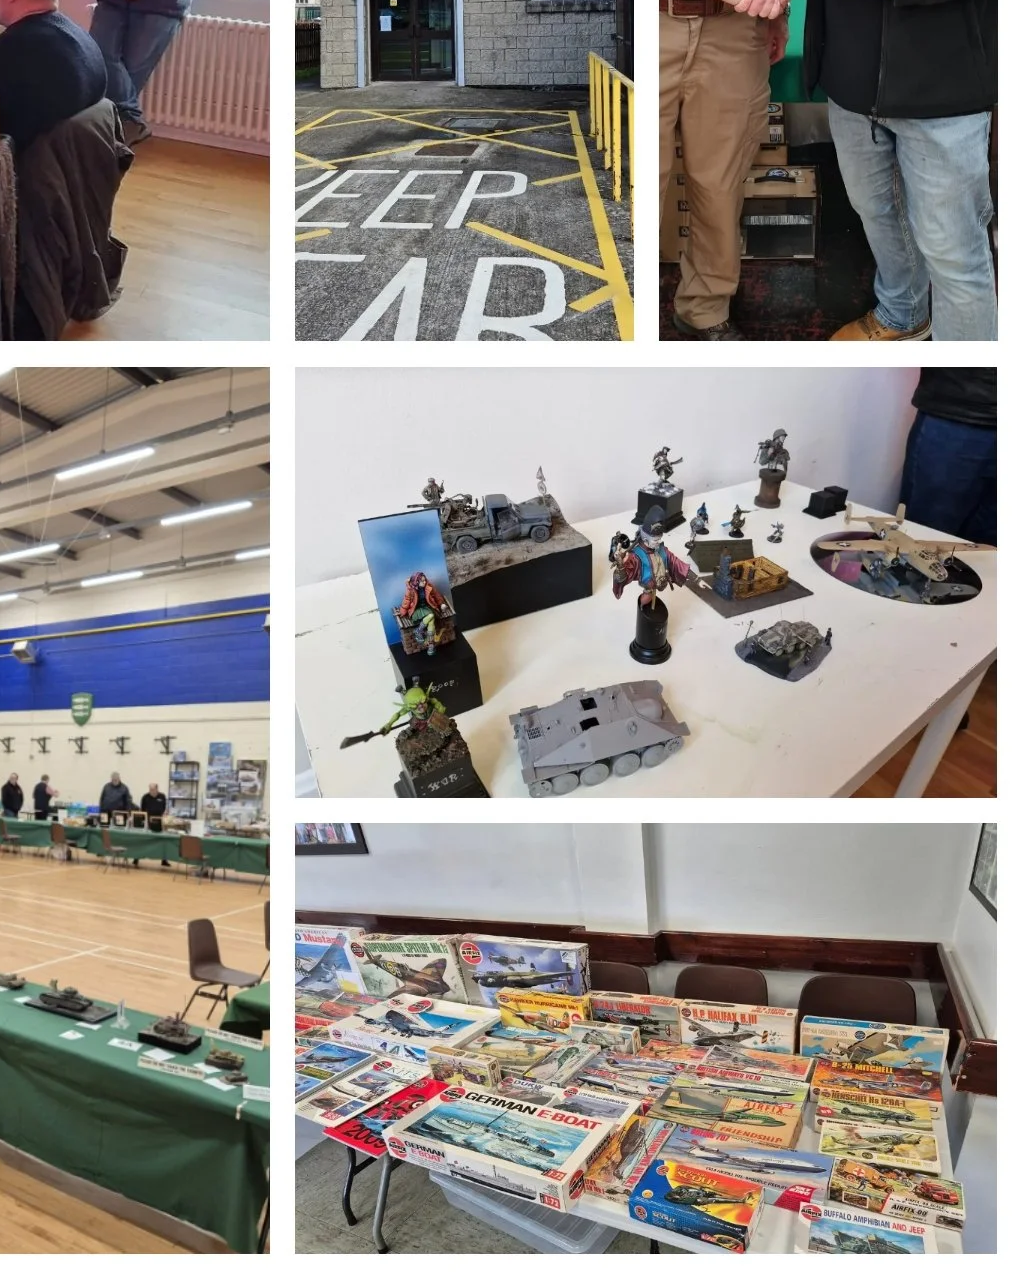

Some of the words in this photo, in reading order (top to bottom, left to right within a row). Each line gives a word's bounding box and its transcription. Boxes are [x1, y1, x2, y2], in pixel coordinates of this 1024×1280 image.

[295, 169, 529, 229] EEP
[855, 1062, 894, 1074] MITCHELL
[465, 1091, 538, 1115] GERMAN
[537, 1109, 602, 1130] E-BOAT
[744, 1101, 785, 1115] AIRFIX
[720, 1126, 783, 1143] FRIENDSHIP
[404, 1140, 445, 1158] GERMAN
[676, 1168, 721, 1187] SCOUT
[652, 1210, 676, 1223] SCOUT
[801, 1208, 822, 1218] AIRFIX
[823, 1209, 851, 1221] BUFFALO
[853, 1215, 891, 1228] AMPHIBIAN
[892, 1222, 907, 1231] AND
[908, 1224, 926, 1235] JEEP
